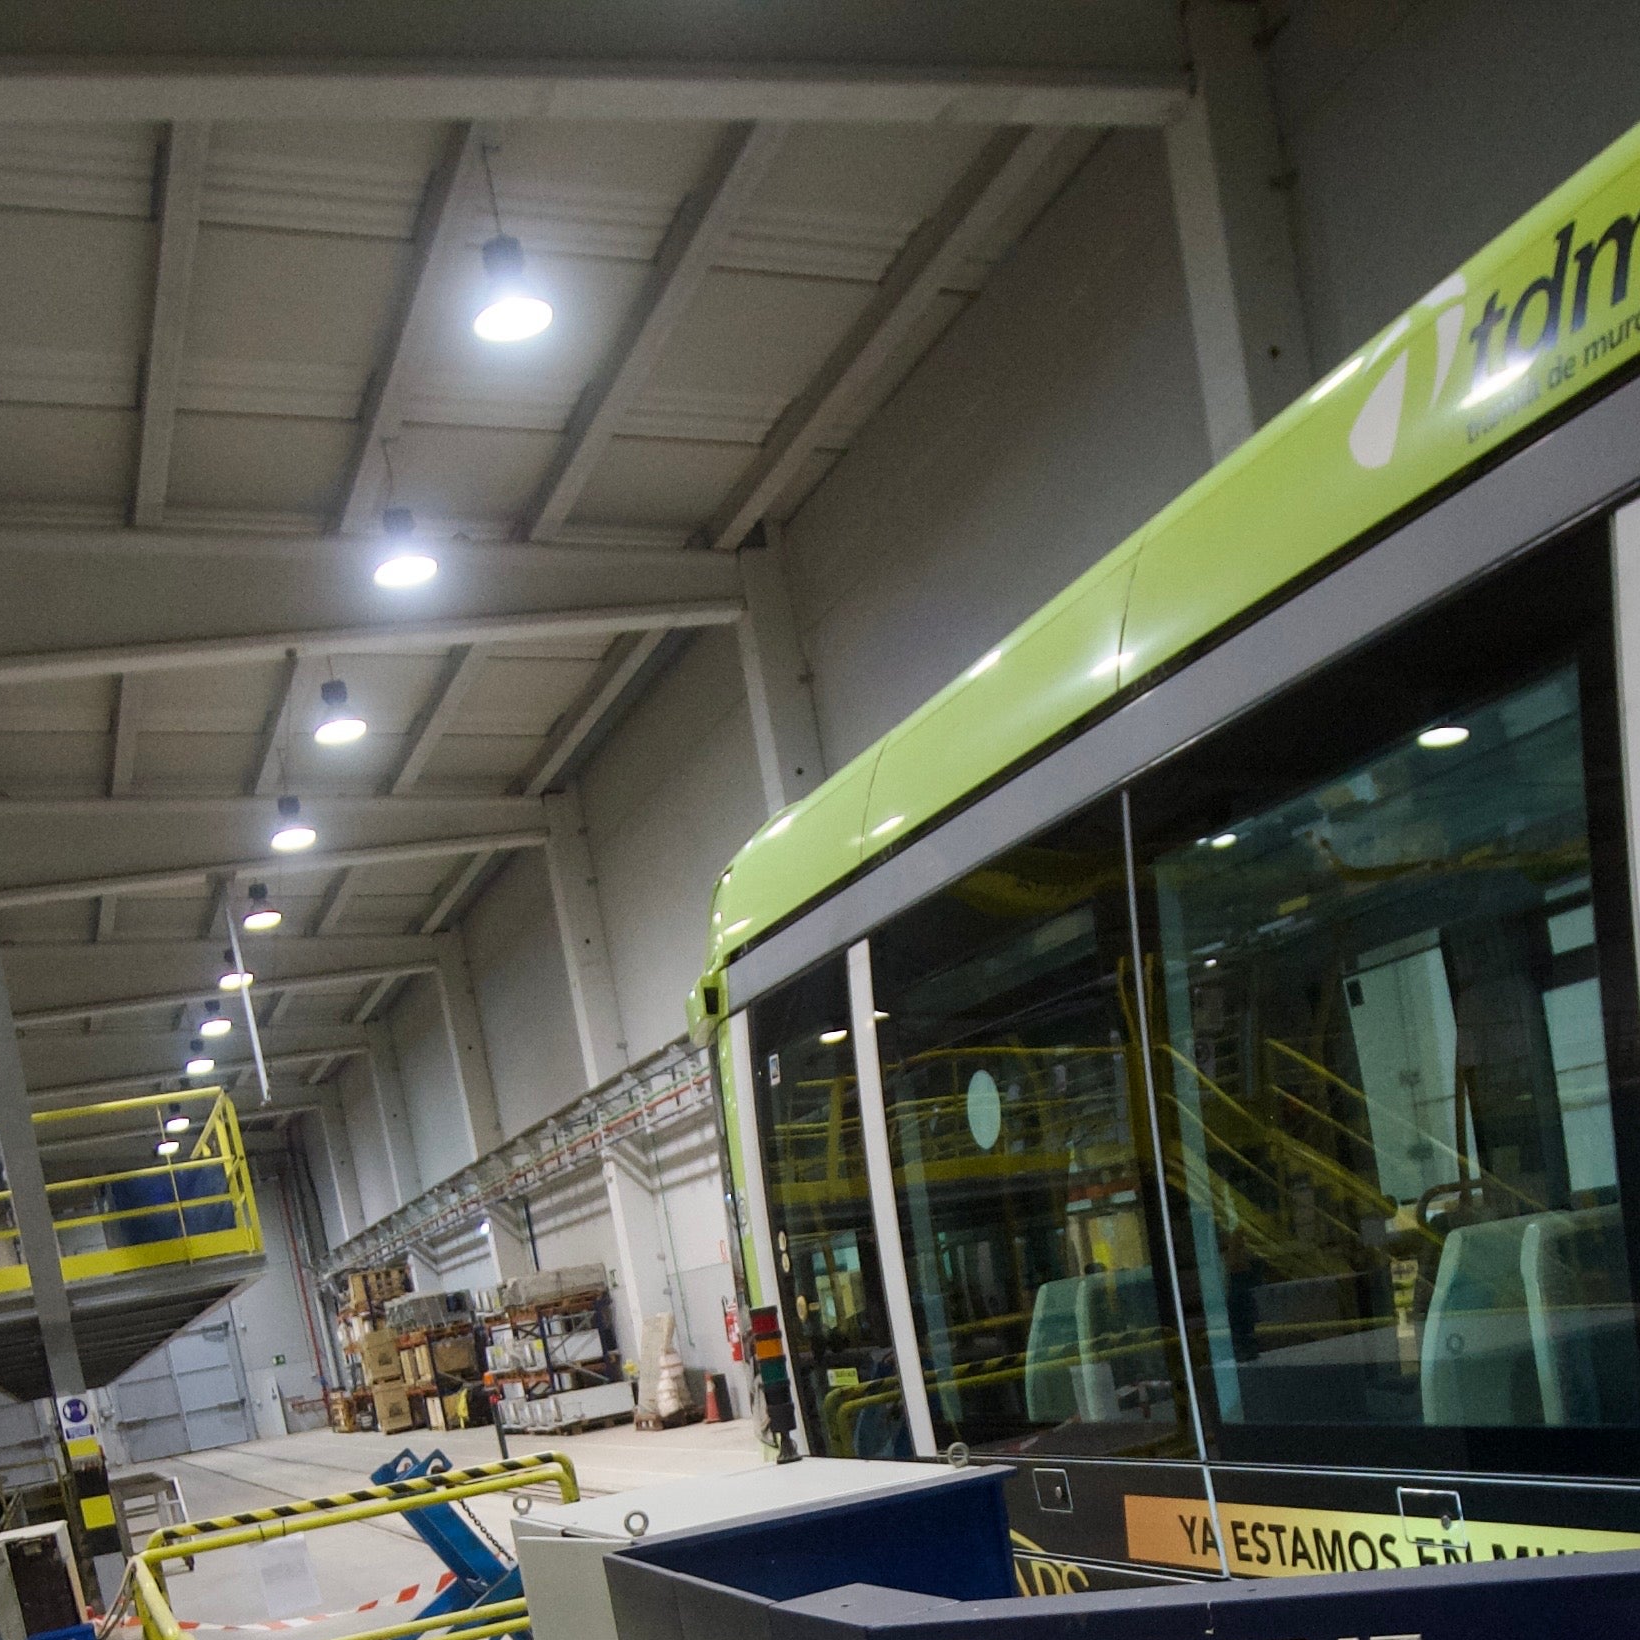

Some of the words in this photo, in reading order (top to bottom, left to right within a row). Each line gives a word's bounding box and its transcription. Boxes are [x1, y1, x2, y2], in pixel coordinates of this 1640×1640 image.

[1547, 354, 1577, 389] de
[1178, 1513, 1222, 1556] YA
[1230, 1519, 1403, 1573] ESTAMOS
